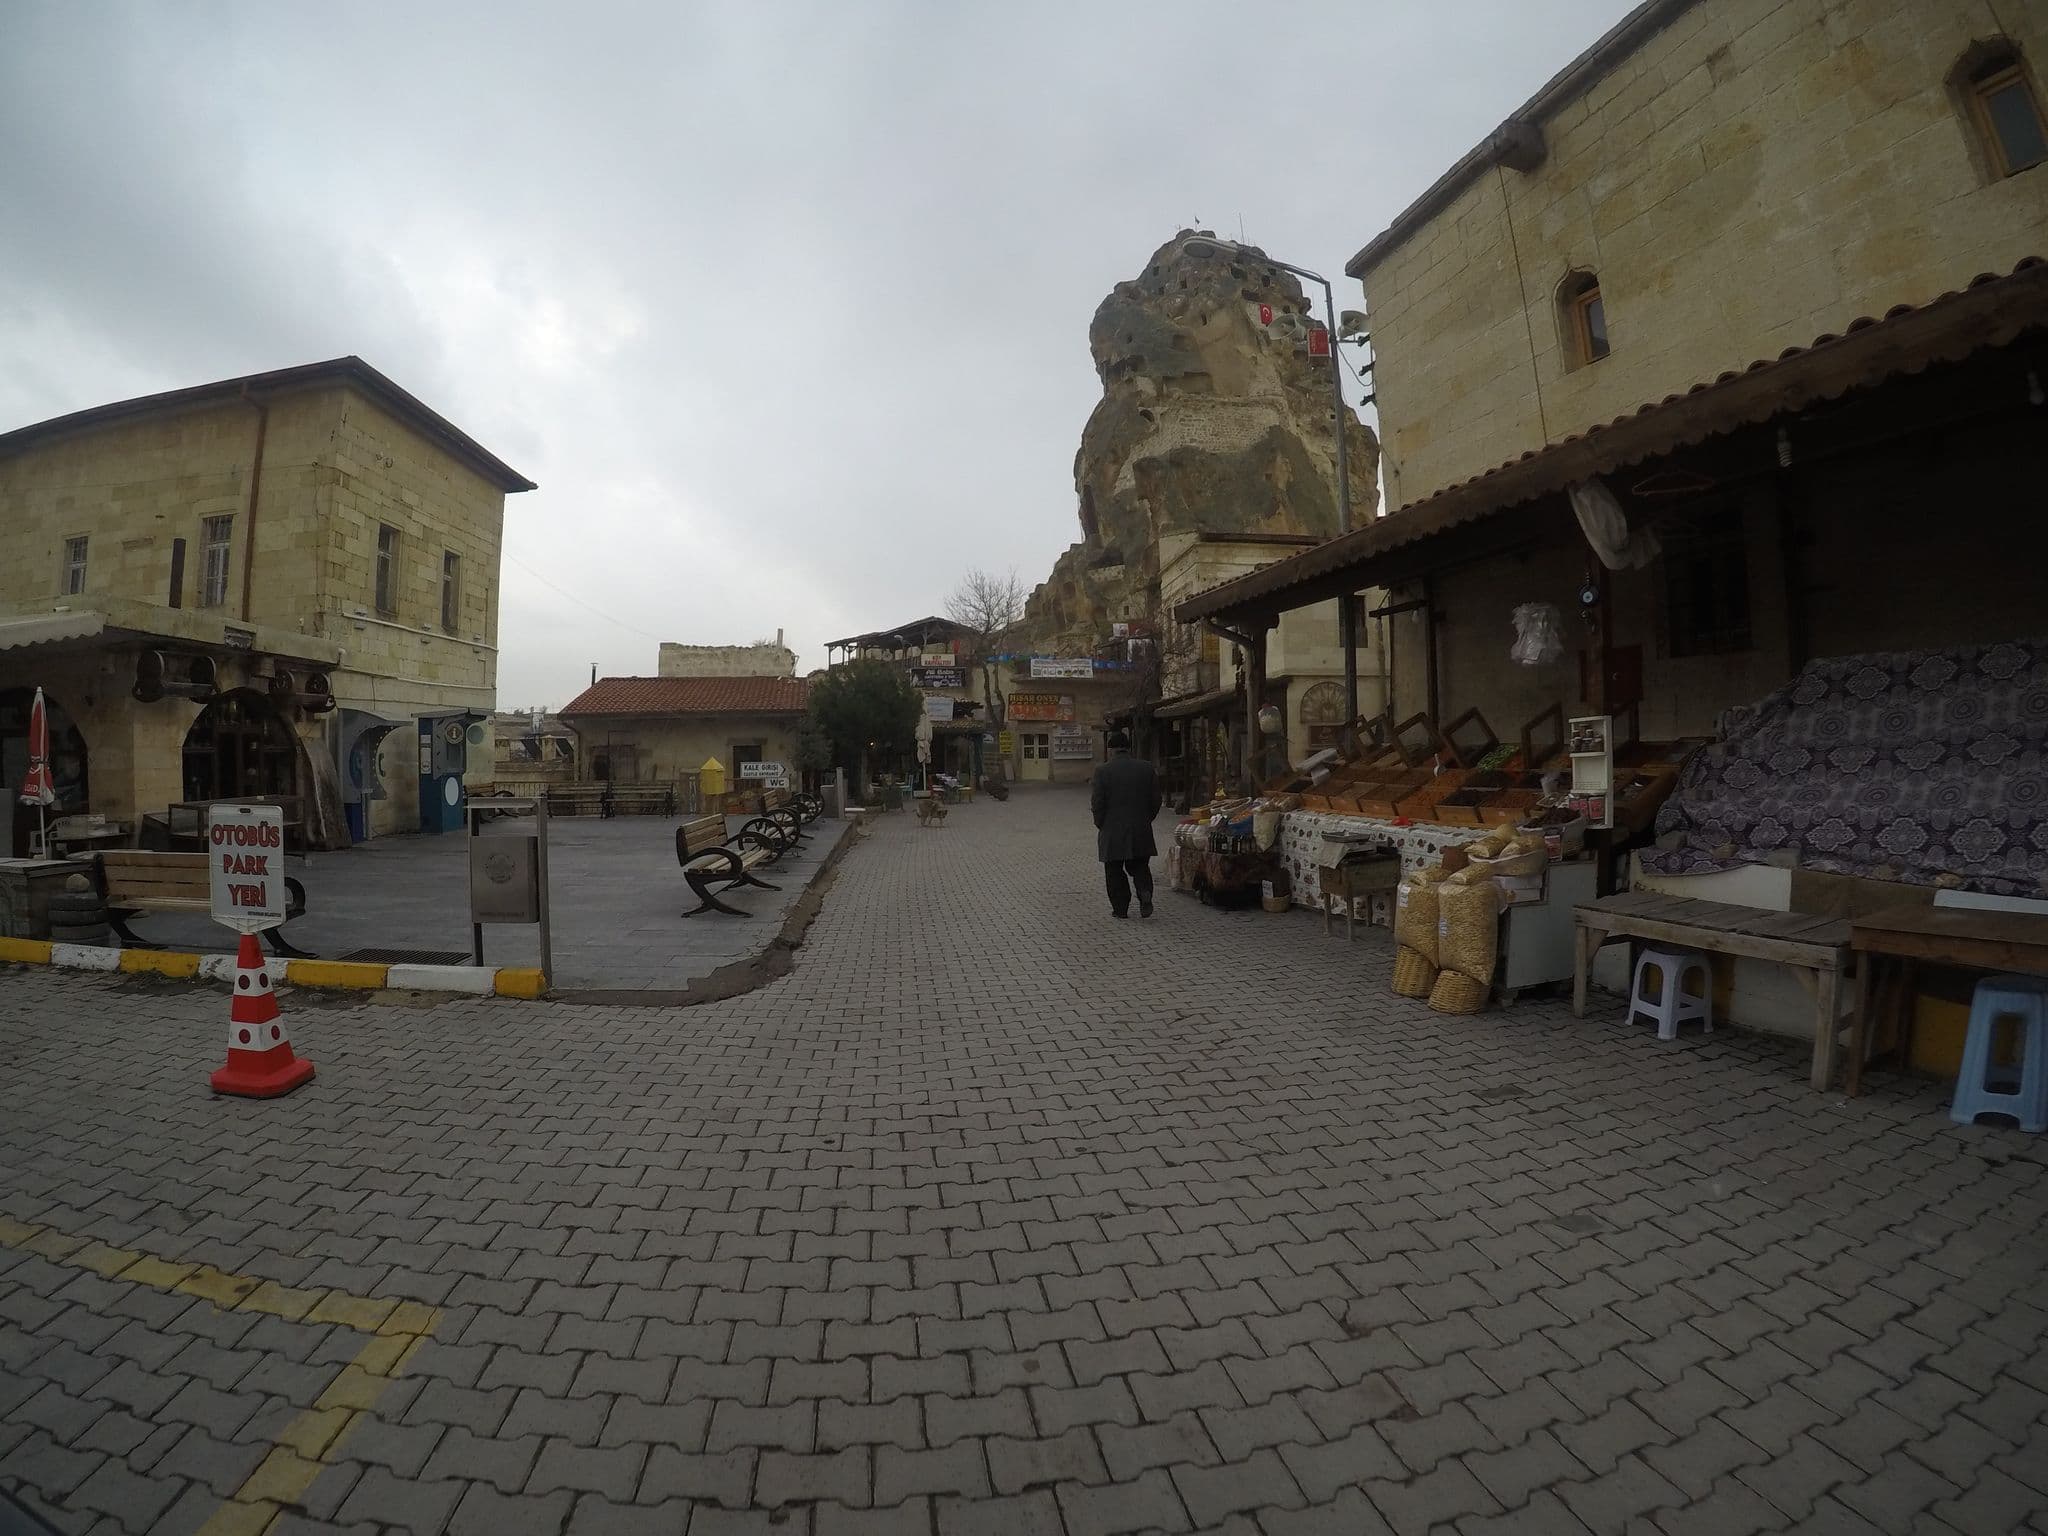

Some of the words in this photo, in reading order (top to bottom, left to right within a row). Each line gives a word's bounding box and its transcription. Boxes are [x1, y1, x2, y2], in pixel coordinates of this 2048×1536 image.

[211, 820, 280, 848] OTOBÜS
[223, 852, 269, 876] PARK
[227, 881, 267, 908] YERİ
